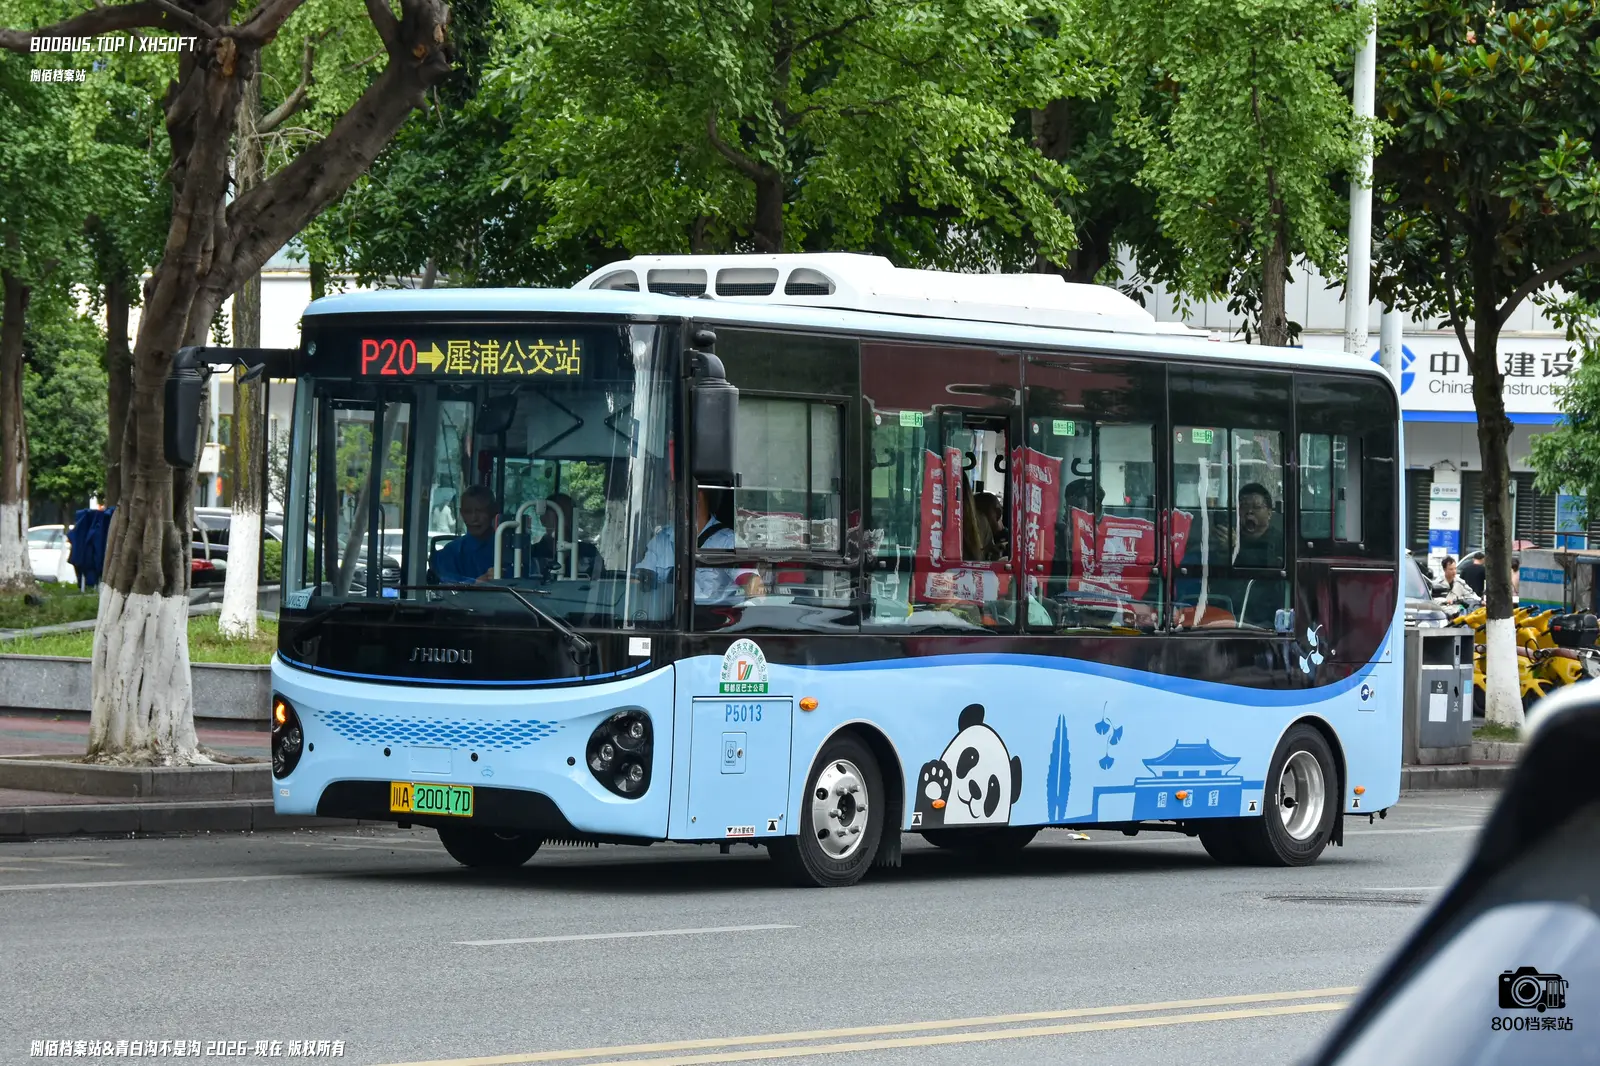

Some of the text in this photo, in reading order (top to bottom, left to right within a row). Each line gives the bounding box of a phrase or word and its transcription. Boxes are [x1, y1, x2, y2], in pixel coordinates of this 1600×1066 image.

[361, 339, 581, 375] P20 犀浦公交站
[1429, 351, 1575, 378] 中建设
[1428, 379, 1473, 394] China
[409, 647, 473, 664] SHUDU
[723, 683, 765, 693] 郫都区巴士公司
[725, 704, 762, 722] P5013
